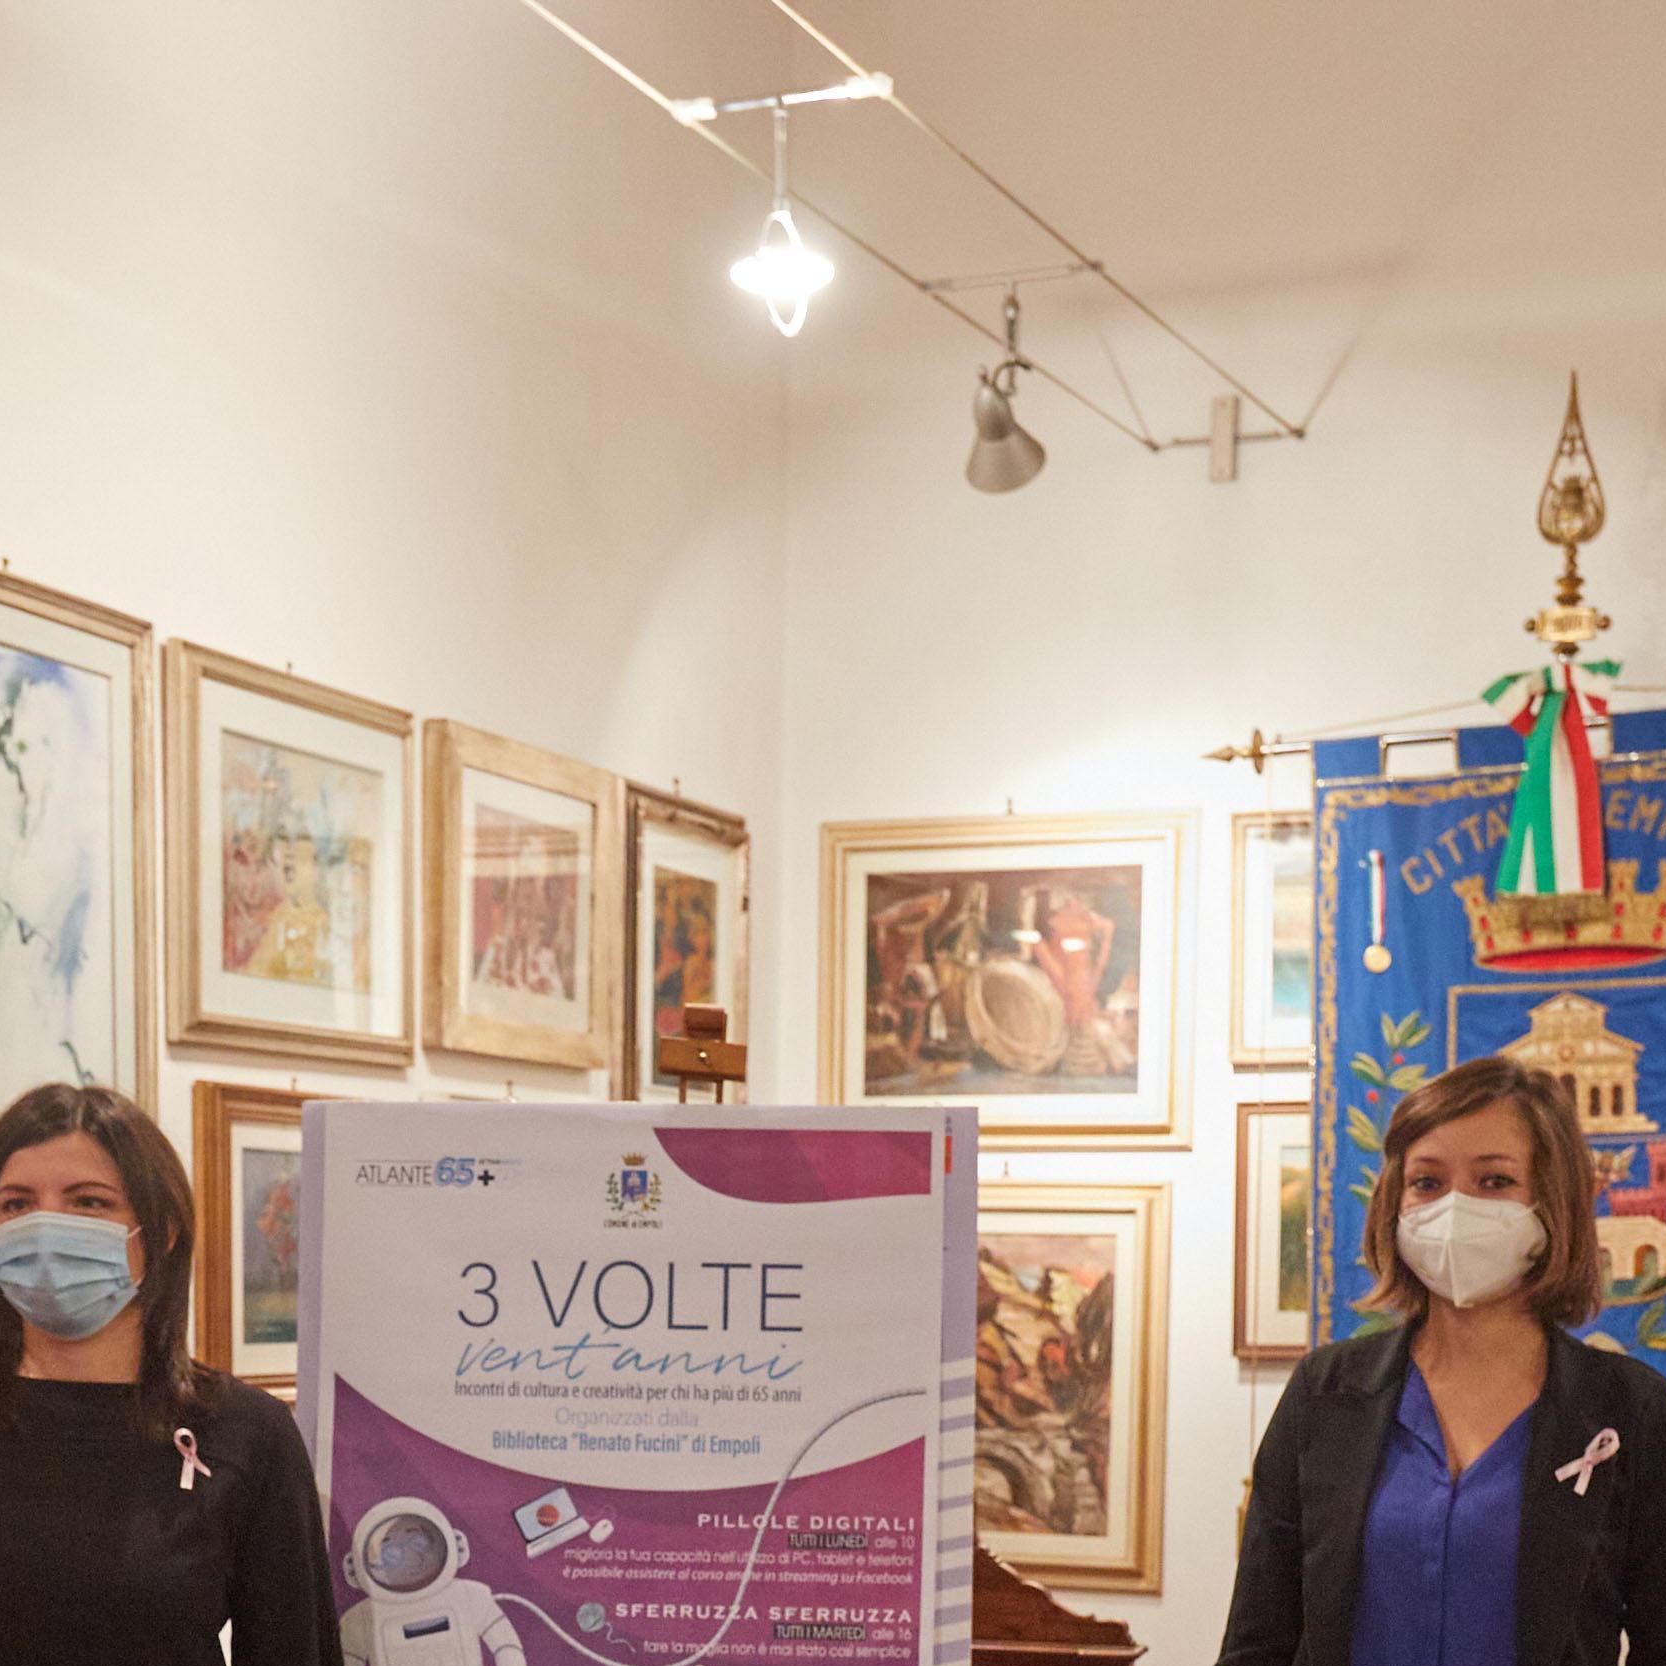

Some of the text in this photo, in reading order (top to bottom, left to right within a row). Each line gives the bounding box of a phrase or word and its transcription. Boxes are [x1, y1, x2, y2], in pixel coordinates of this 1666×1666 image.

[458, 1260, 804, 1331] 3 VOLTE
[455, 1380, 801, 1405] Incontri di cultura e creatività per chi ha più di 65 anni
[555, 1406, 699, 1428] Organizzati dalla
[492, 1430, 761, 1458] Biblioteca "Renato Fucini" di Empoli
[697, 1513, 915, 1532] PILLOLE DIGITALI
[790, 1533, 818, 1547] TUTTI
[874, 1535, 897, 1549] alle
[901, 1535, 915, 1549] 10
[564, 1548, 613, 1562] migliora
[614, 1548, 627, 1561] la
[630, 1548, 651, 1561] tua
[778, 1551, 789, 1564] di
[817, 1552, 853, 1566] tablet
[856, 1555, 865, 1566] e
[869, 1553, 913, 1567] telefoni
[571, 1567, 623, 1579] possibile
[625, 1567, 676, 1579] assistere
[678, 1568, 690, 1580] al
[692, 1570, 723, 1581] corso
[765, 1571, 776, 1581] in
[779, 1571, 838, 1586] streaming
[840, 1574, 853, 1583] su
[856, 1572, 912, 1584] Facebook
[769, 1606, 912, 1623] SFERRUZZA
[776, 1625, 804, 1638] TUTTI
[871, 1628, 894, 1641] alle
[899, 1628, 913, 1641] 16
[672, 1641, 684, 1653] la
[731, 1643, 756, 1655] non
[769, 1643, 793, 1656] mai
[796, 1643, 827, 1656] stato
[856, 1645, 911, 1659] semplice
